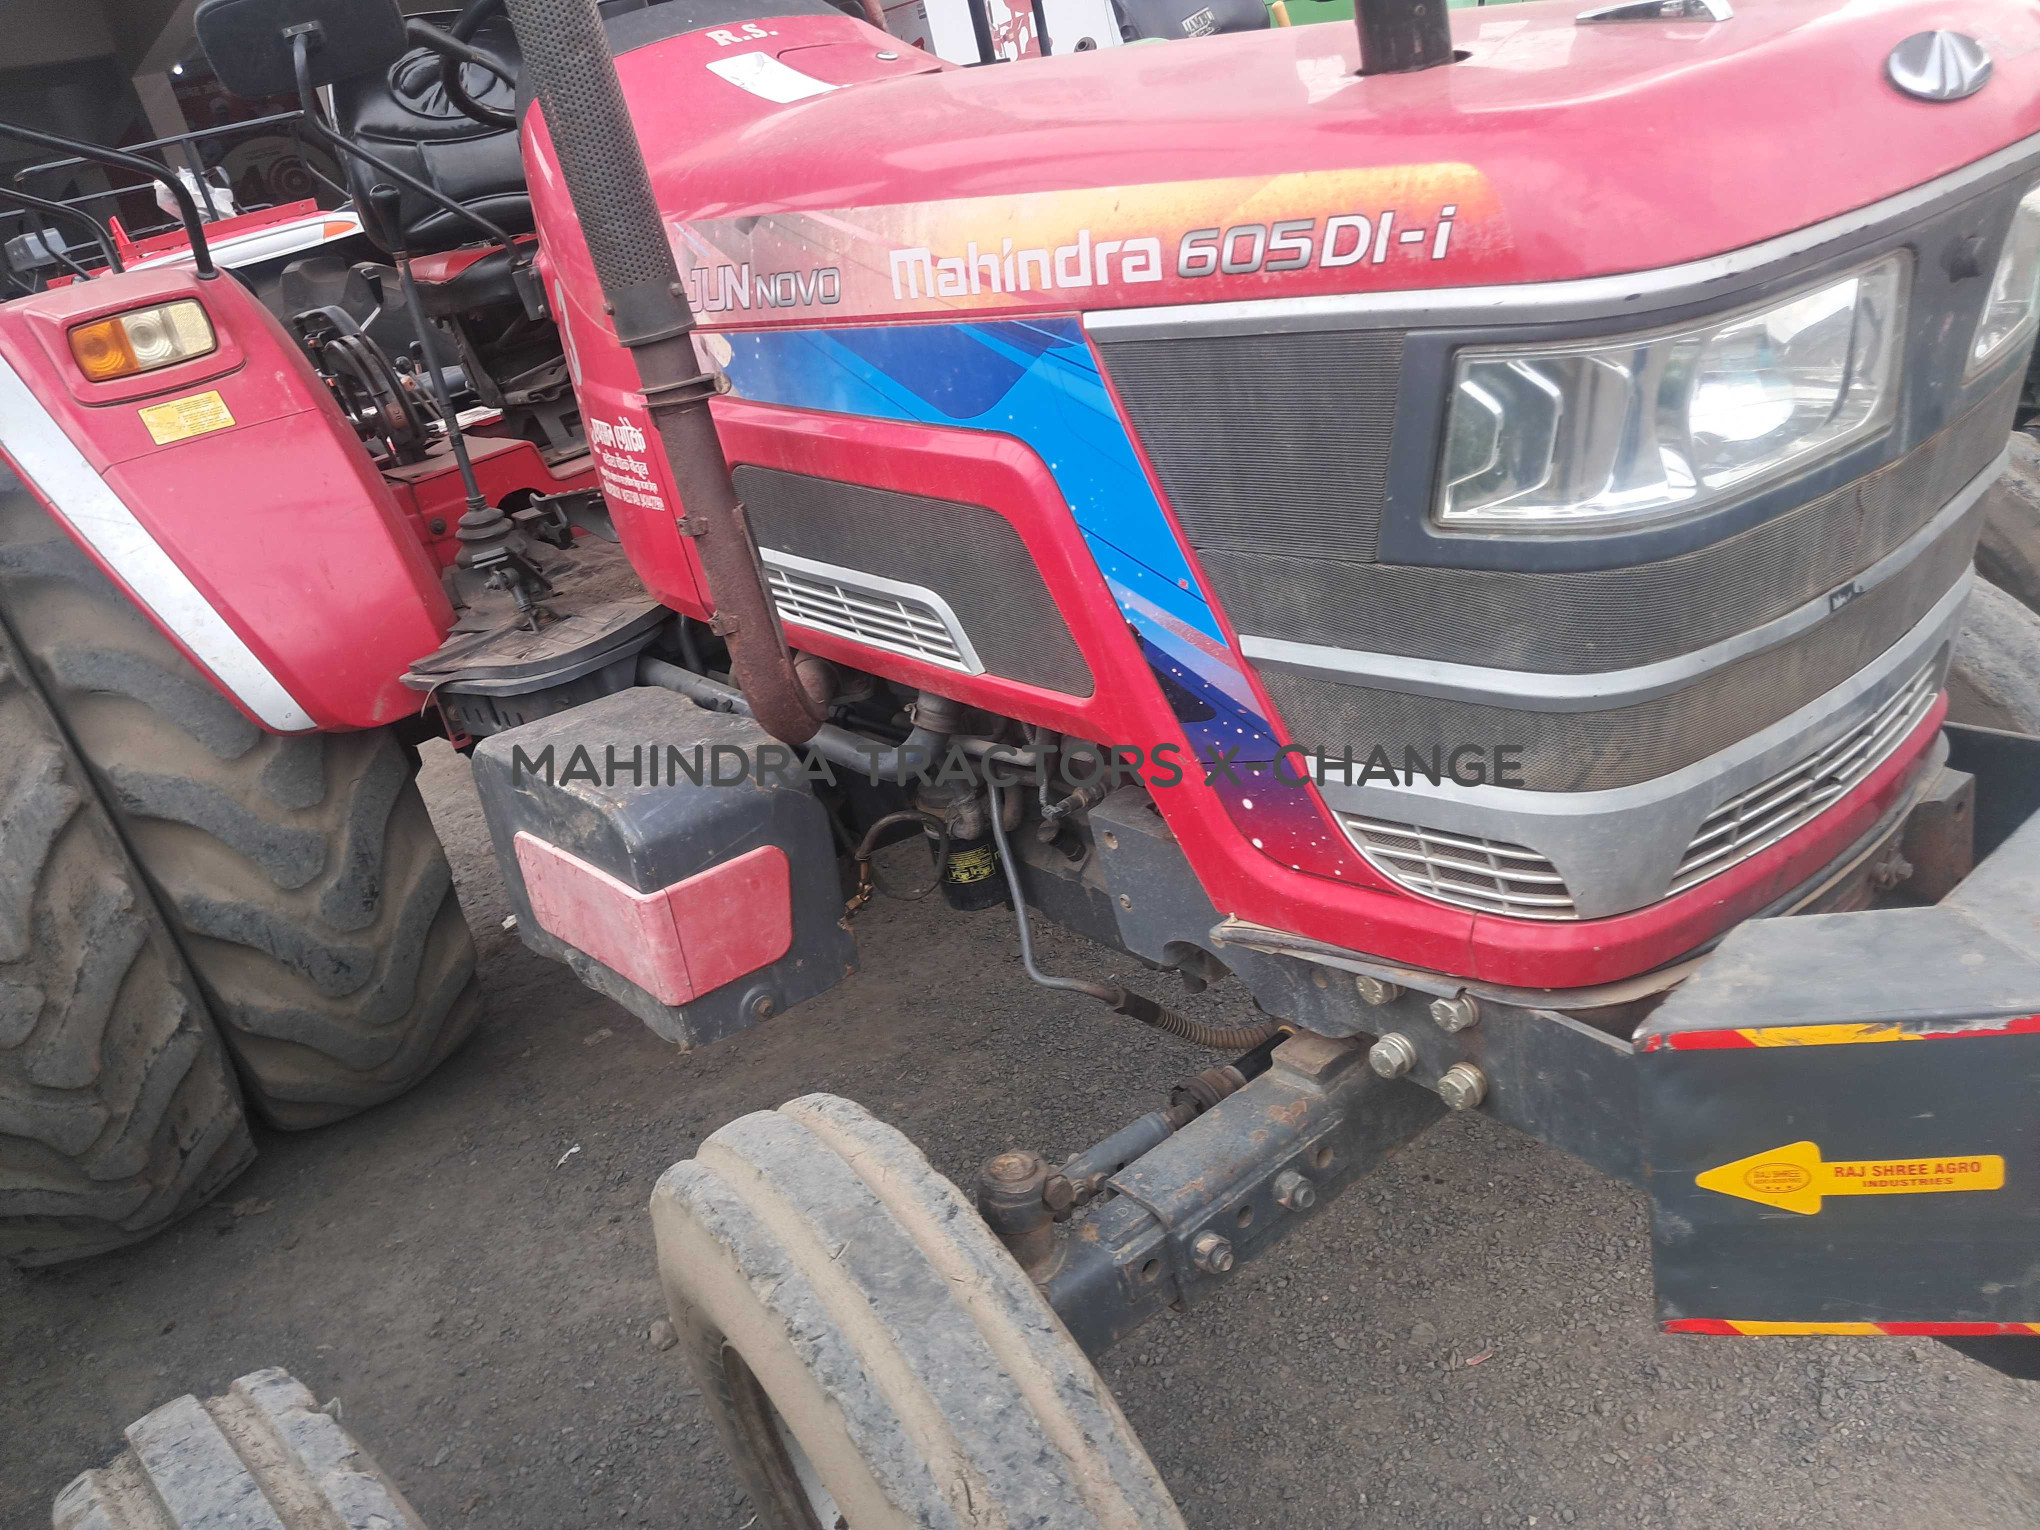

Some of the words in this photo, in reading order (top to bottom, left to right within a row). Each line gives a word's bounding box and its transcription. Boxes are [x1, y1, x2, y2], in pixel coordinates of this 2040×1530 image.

[705, 23, 779, 47] R.S.
[889, 229, 1163, 300] Mahindra
[755, 266, 841, 309] NOVO
[1834, 1166, 1866, 1178] RAJ
[1872, 1163, 1928, 1177] SHREE
[1934, 1161, 1982, 1175] AGRO
[1862, 1177, 1954, 1188] INDUSTRIES
